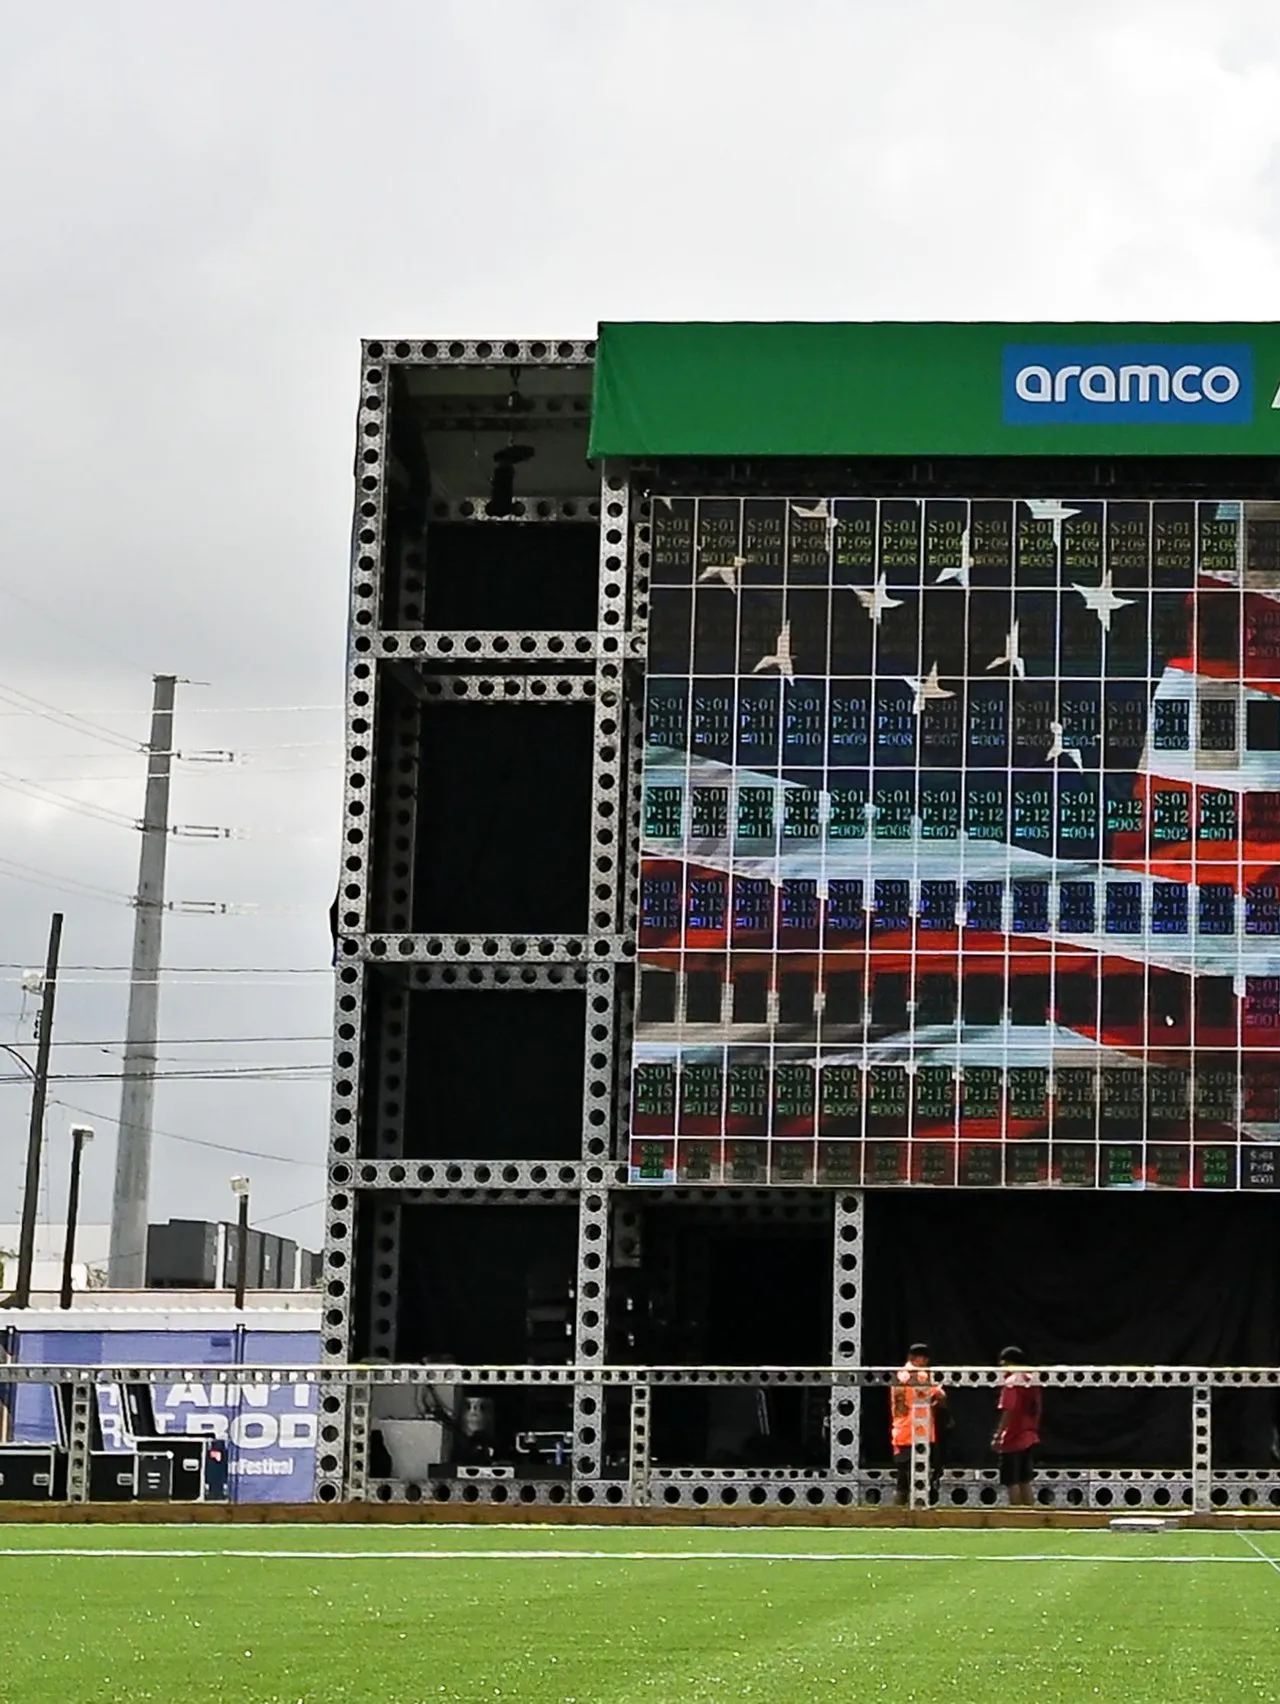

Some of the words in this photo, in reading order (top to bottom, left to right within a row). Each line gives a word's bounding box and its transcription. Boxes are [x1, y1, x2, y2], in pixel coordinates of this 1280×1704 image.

[1015, 364, 1239, 403] aramco
[656, 521, 691, 532] S:01
[701, 521, 736, 533] S:01
[747, 521, 782, 533] S:01
[882, 522, 917, 534] S:01
[928, 522, 963, 534] S:01
[973, 522, 1008, 534] S:01
[1019, 522, 1054, 534] S:01
[1064, 523, 1099, 534] S:01
[1110, 523, 1145, 535] S:01
[1155, 523, 1190, 535] S:01
[1201, 523, 1236, 535] S:01
